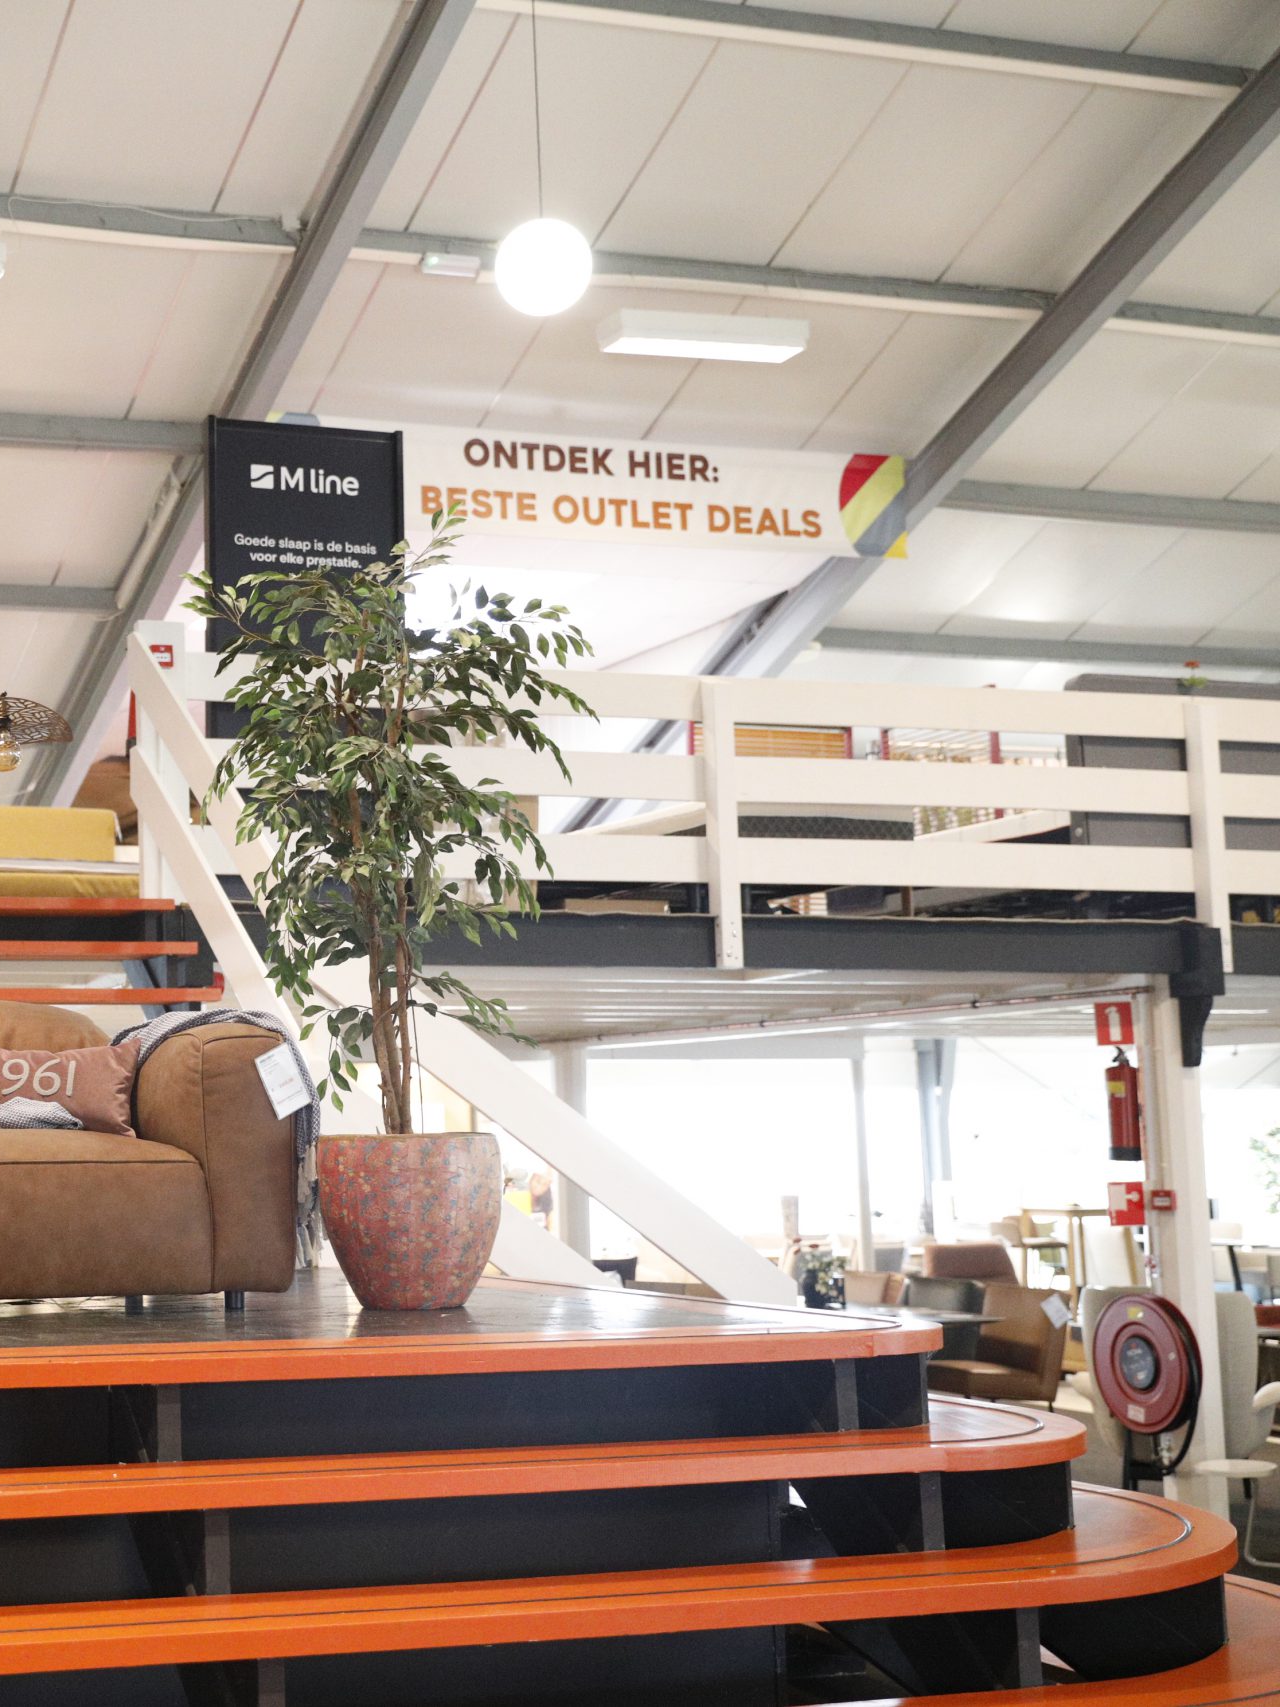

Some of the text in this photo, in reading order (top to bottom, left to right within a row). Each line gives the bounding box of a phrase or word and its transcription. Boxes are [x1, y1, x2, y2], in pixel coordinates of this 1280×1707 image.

[463, 438, 719, 483] ONTDEK HIER:
[280, 466, 359, 496] M line
[421, 485, 823, 539] BESTE OUTLET DEALS
[234, 533, 377, 555] Goede slaap is de basis
[250, 552, 362, 569] voor elke prestatie.
